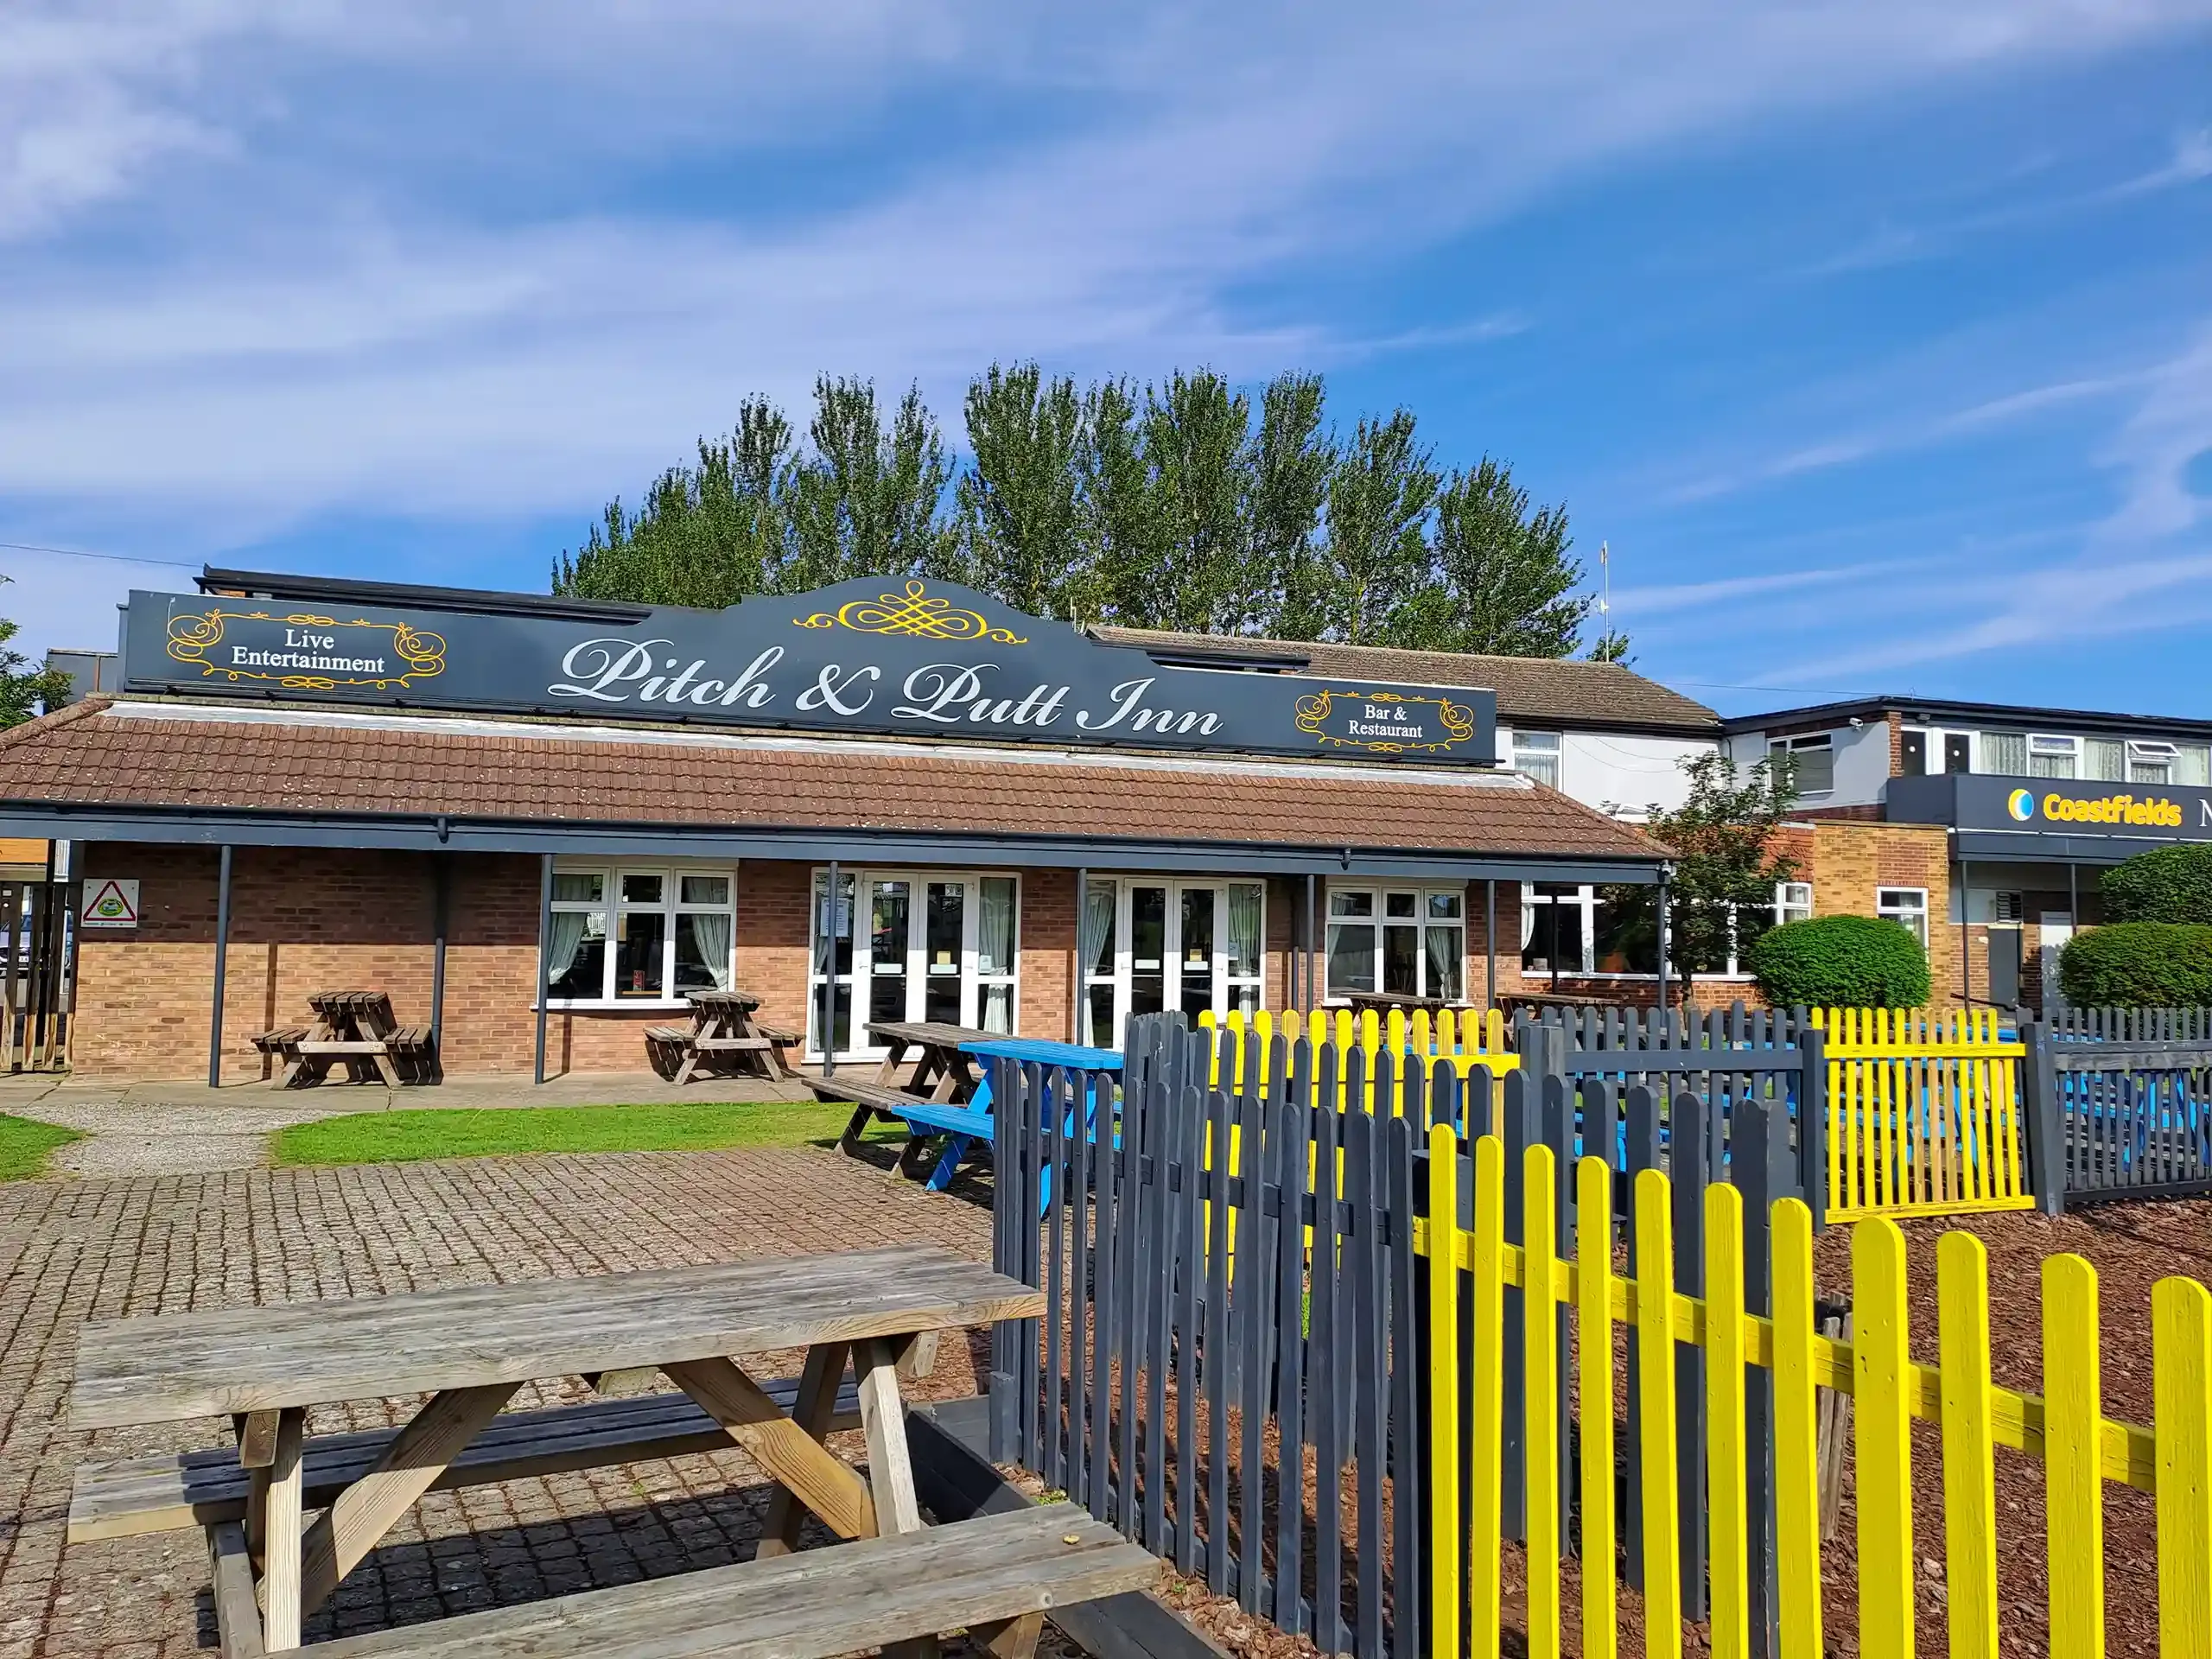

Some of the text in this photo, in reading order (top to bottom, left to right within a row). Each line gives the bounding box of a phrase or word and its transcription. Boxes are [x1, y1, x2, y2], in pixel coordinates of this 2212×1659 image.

[284, 629, 334, 649] Live
[231, 646, 385, 672] Entertainment
[547, 638, 1224, 736] Pitch & Putt Inn
[1364, 704, 1407, 720] Bar &
[1348, 720, 1423, 738] Restaurant
[2043, 793, 2182, 827] Coastfields
